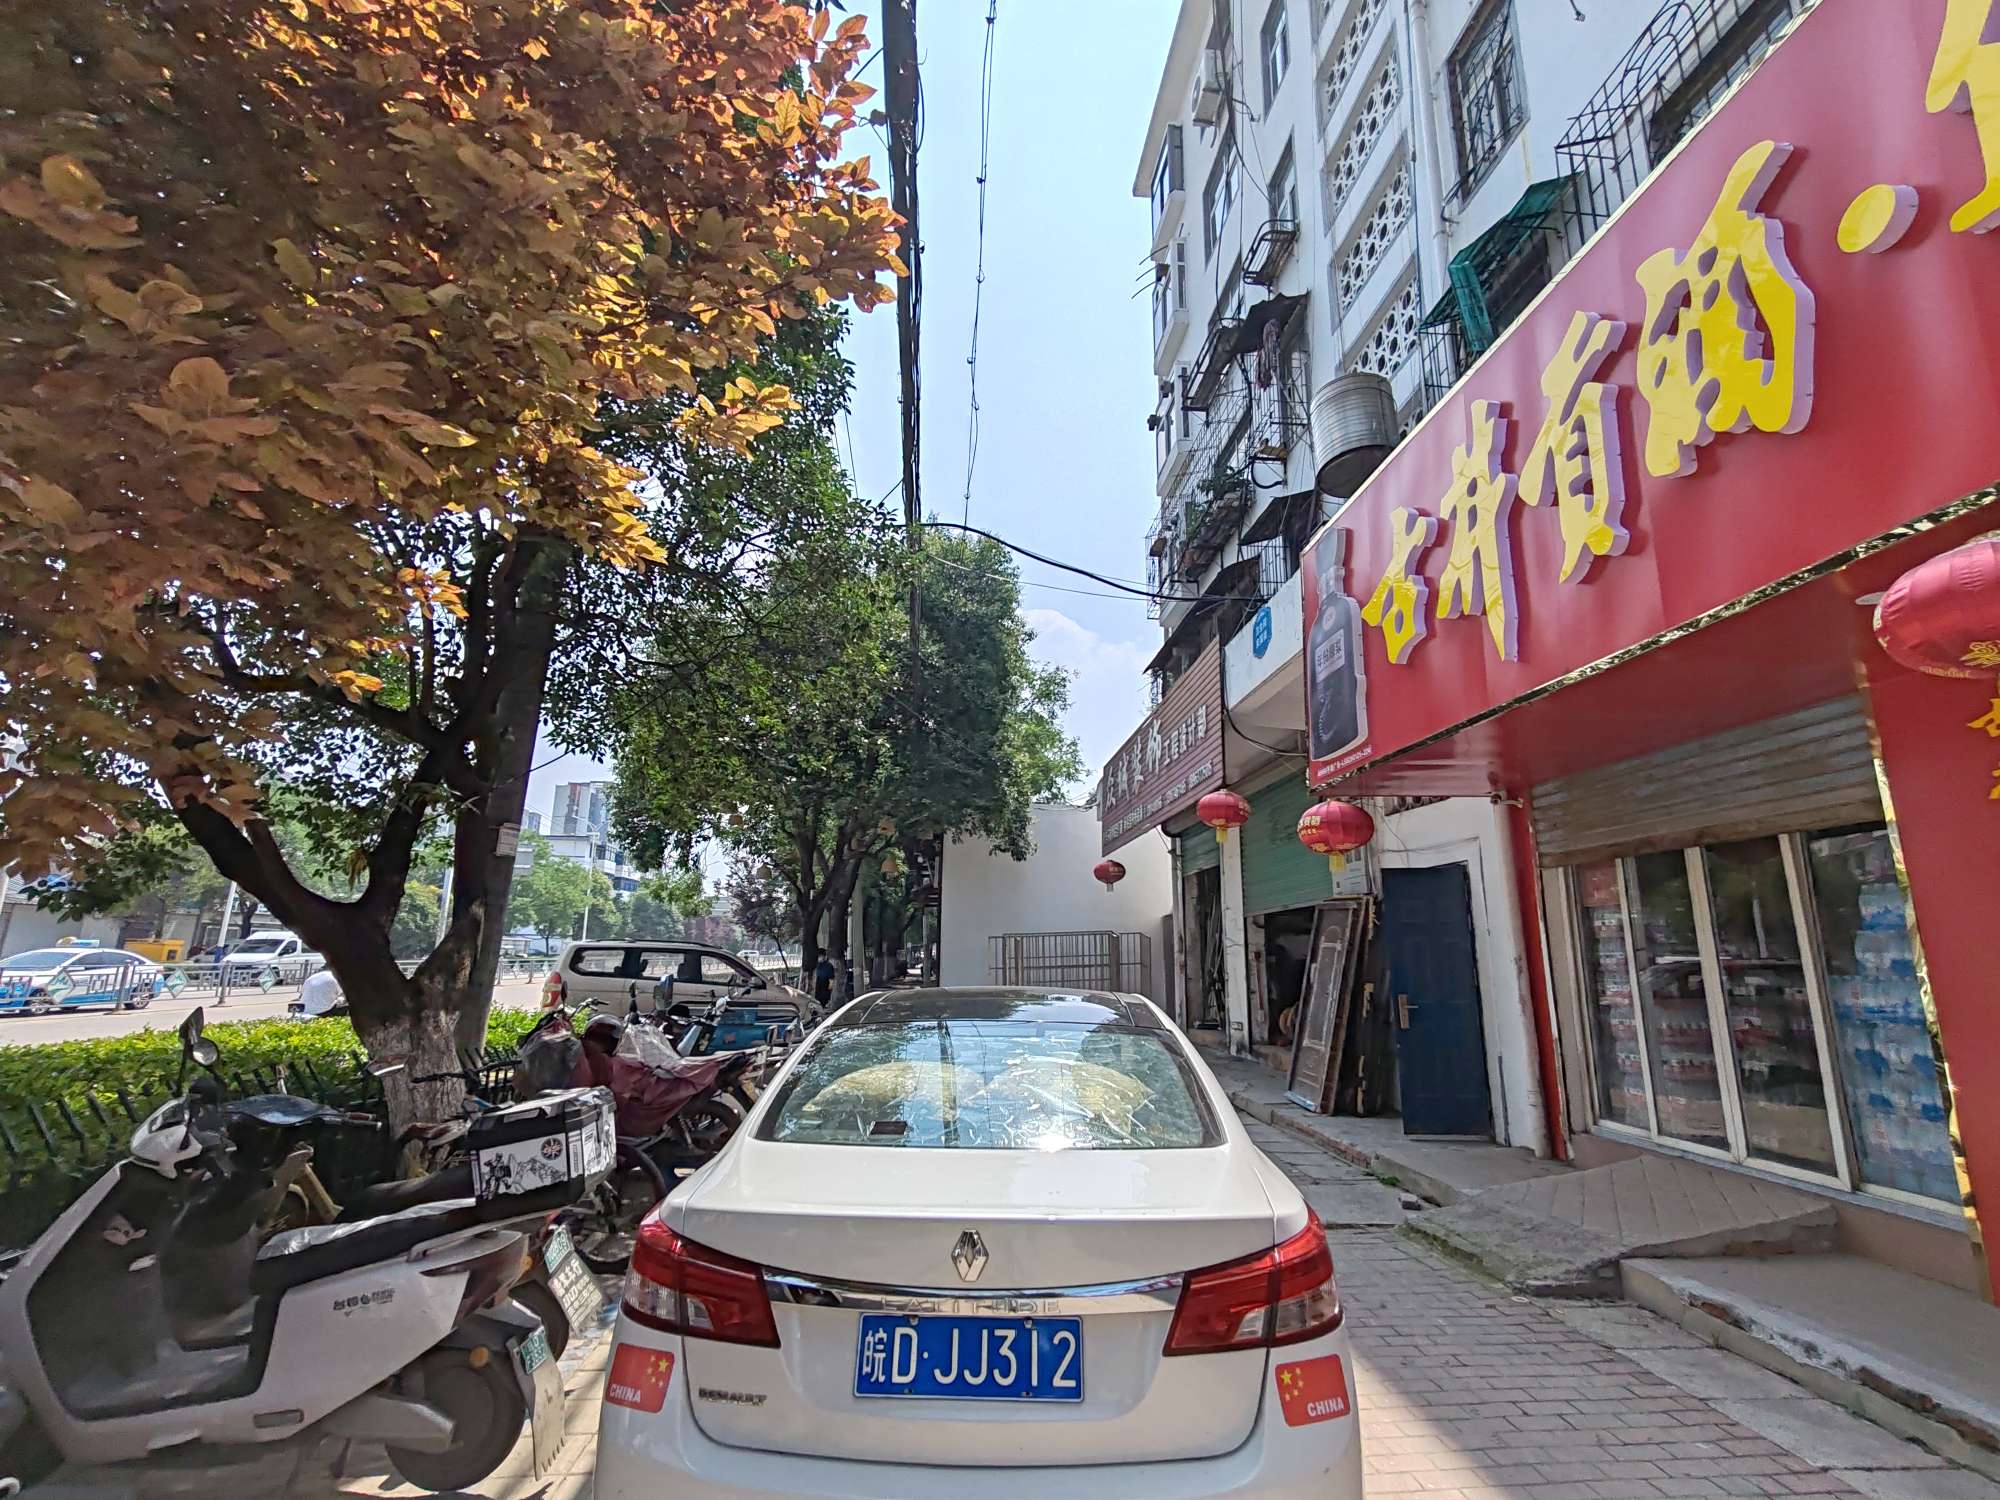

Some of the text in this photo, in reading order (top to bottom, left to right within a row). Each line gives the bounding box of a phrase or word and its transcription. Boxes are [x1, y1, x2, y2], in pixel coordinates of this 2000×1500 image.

[880, 1296, 1062, 1314] LATITUDE
[862, 1326, 1078, 1389] 皖D·JJ312
[609, 1383, 642, 1404] CHINA
[698, 1387, 767, 1406] RENAULT
[1307, 1396, 1345, 1417] CHINA
